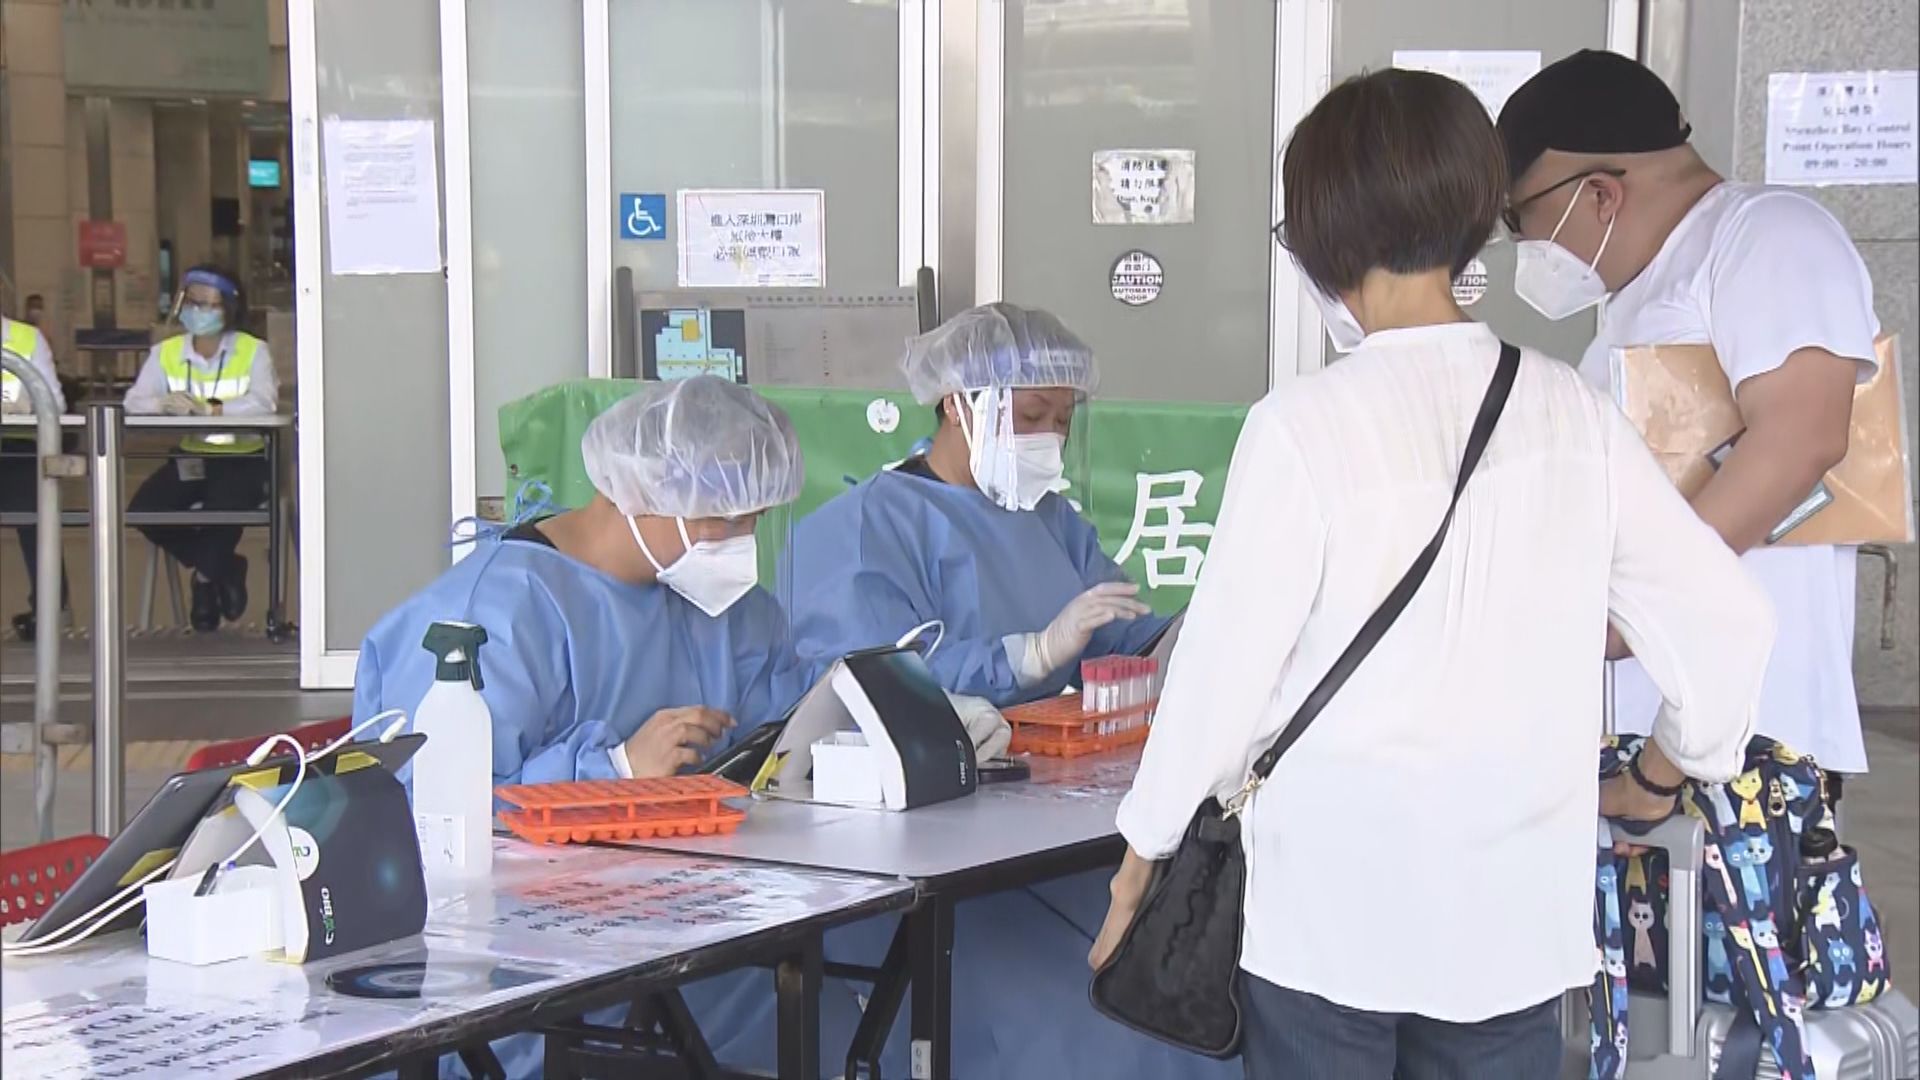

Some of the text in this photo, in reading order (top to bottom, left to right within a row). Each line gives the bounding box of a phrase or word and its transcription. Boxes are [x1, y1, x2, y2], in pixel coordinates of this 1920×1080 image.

[1842, 125, 1863, 136] Bay
[1867, 123, 1911, 133] Control
[1783, 141, 1911, 153] Point Operation Hours
[1112, 275, 1163, 285] CAUTION
[1113, 470, 1216, 590] 居
